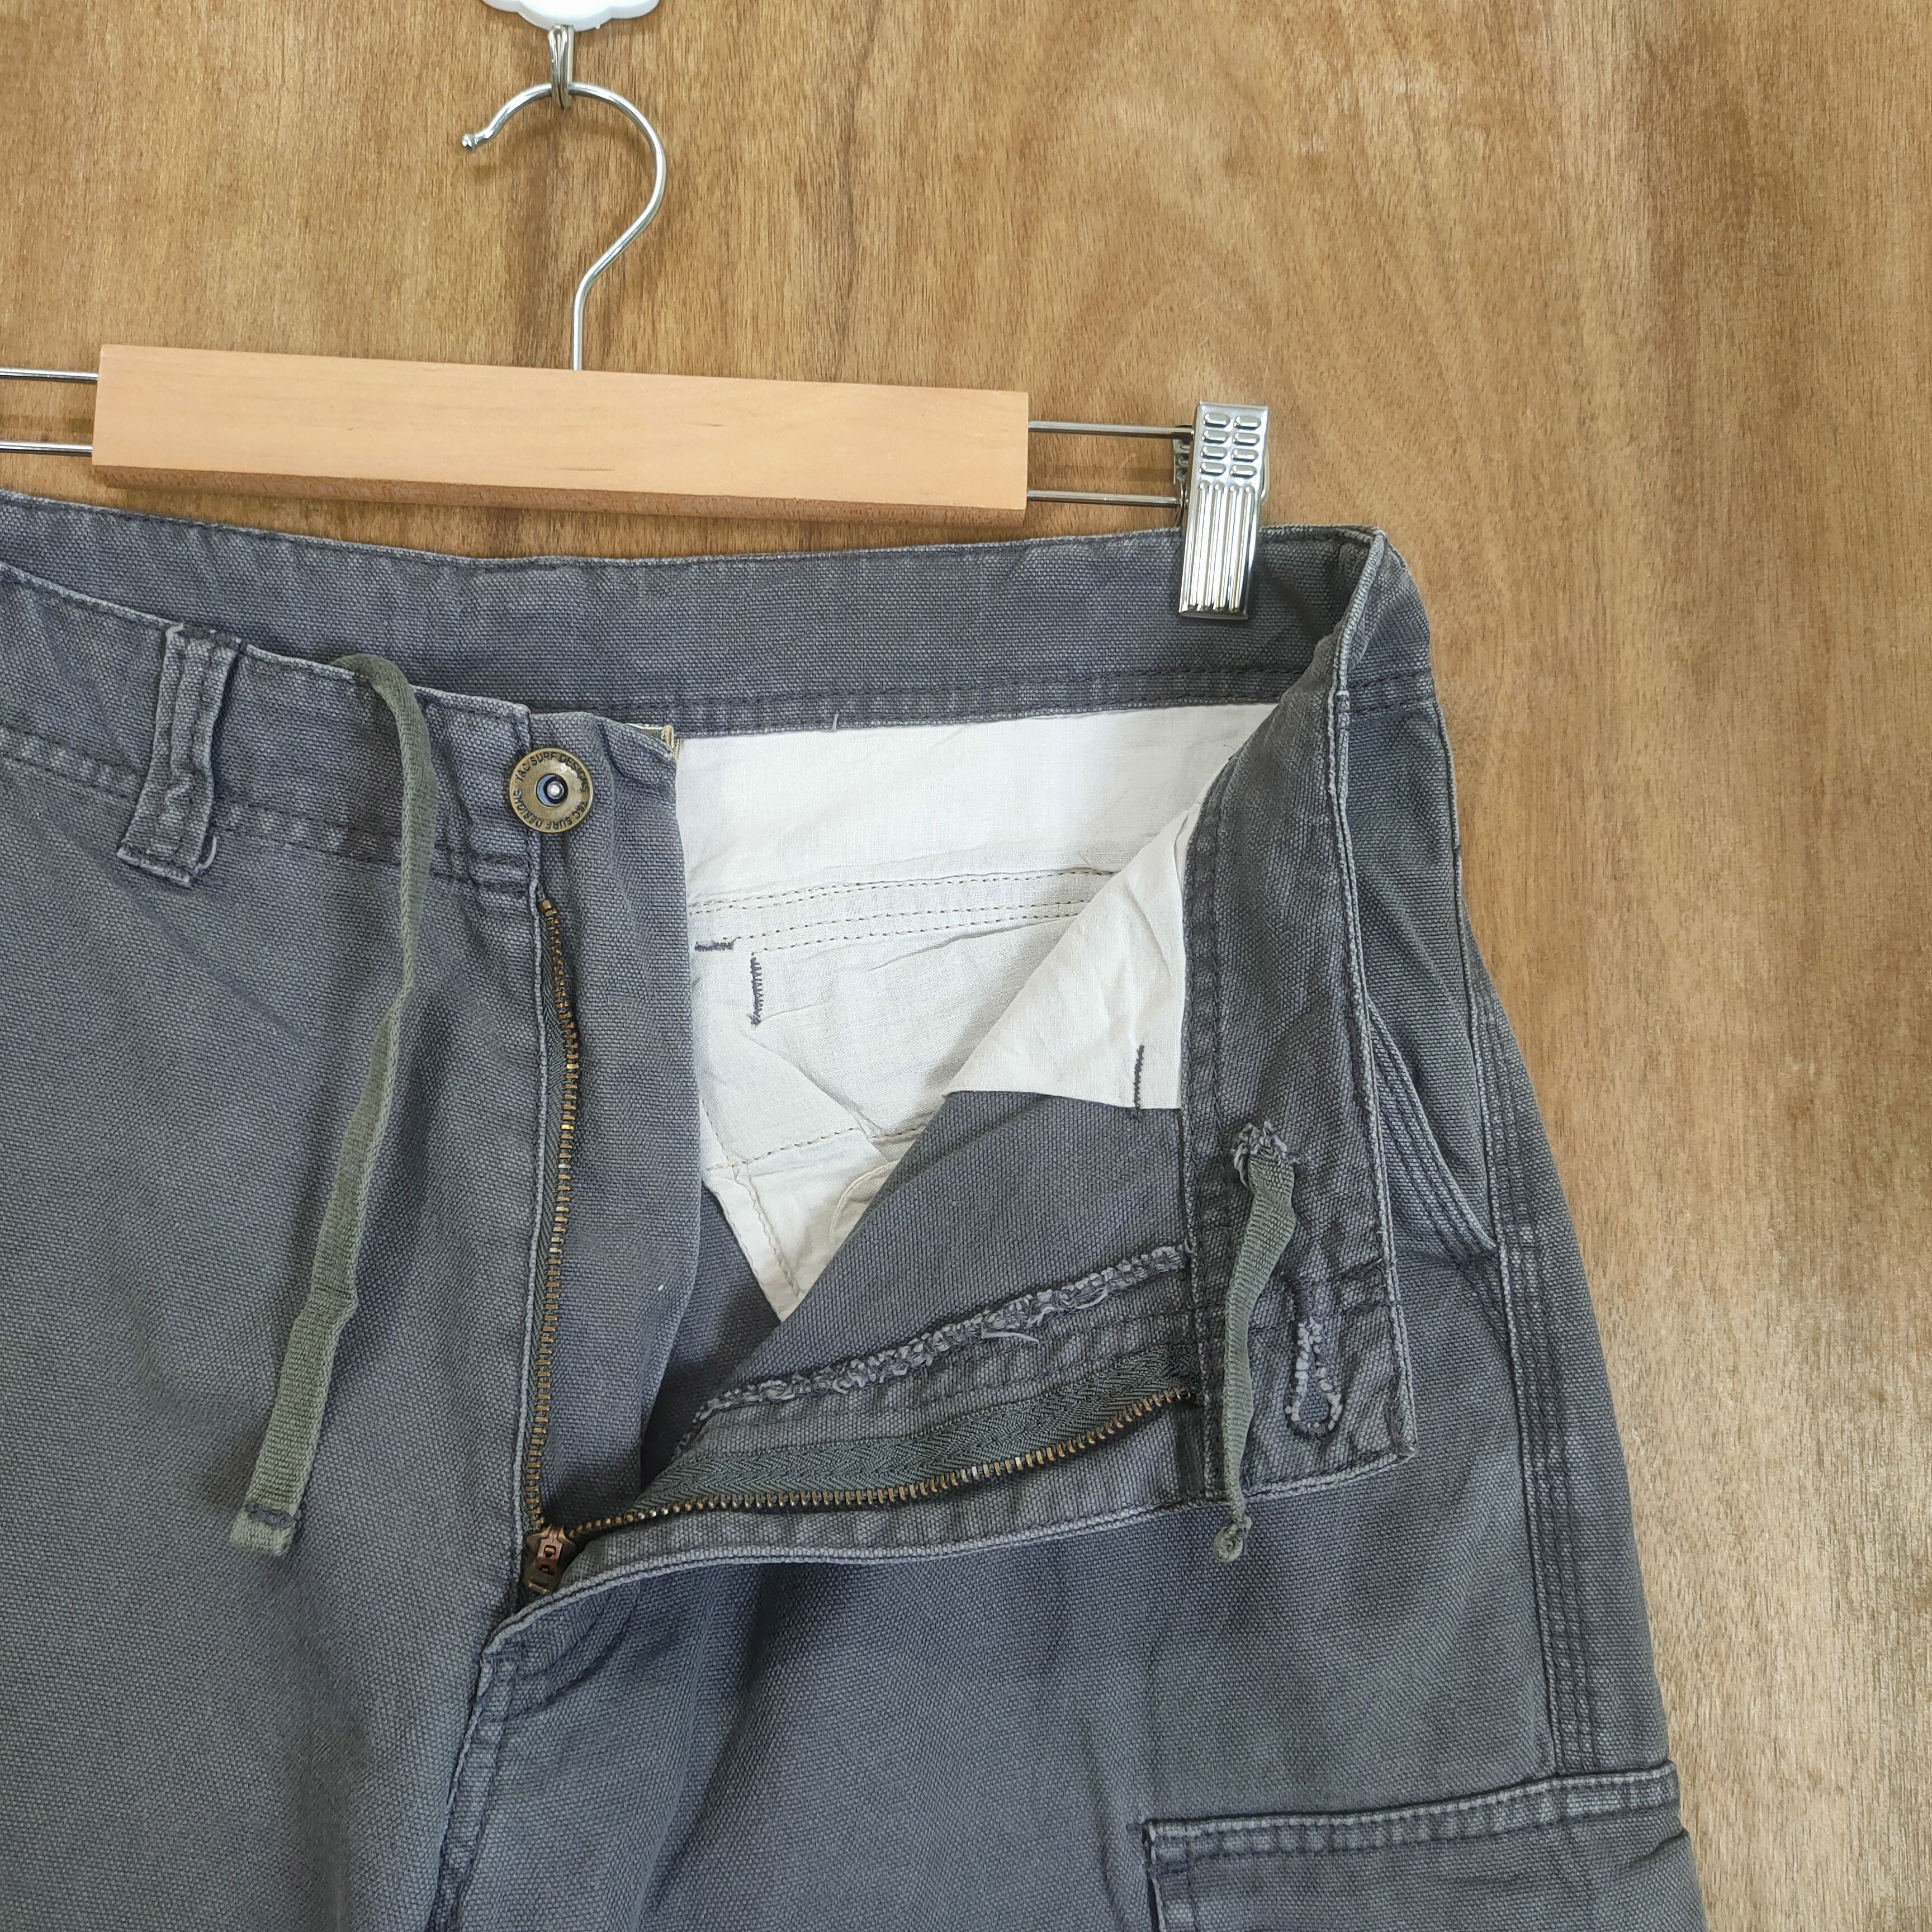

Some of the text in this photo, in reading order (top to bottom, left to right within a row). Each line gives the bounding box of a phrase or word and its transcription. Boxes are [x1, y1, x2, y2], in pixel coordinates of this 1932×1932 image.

[530, 752, 557, 766] SURF
[559, 754, 589, 793] DESIGNS
[546, 817, 572, 830] SURF
